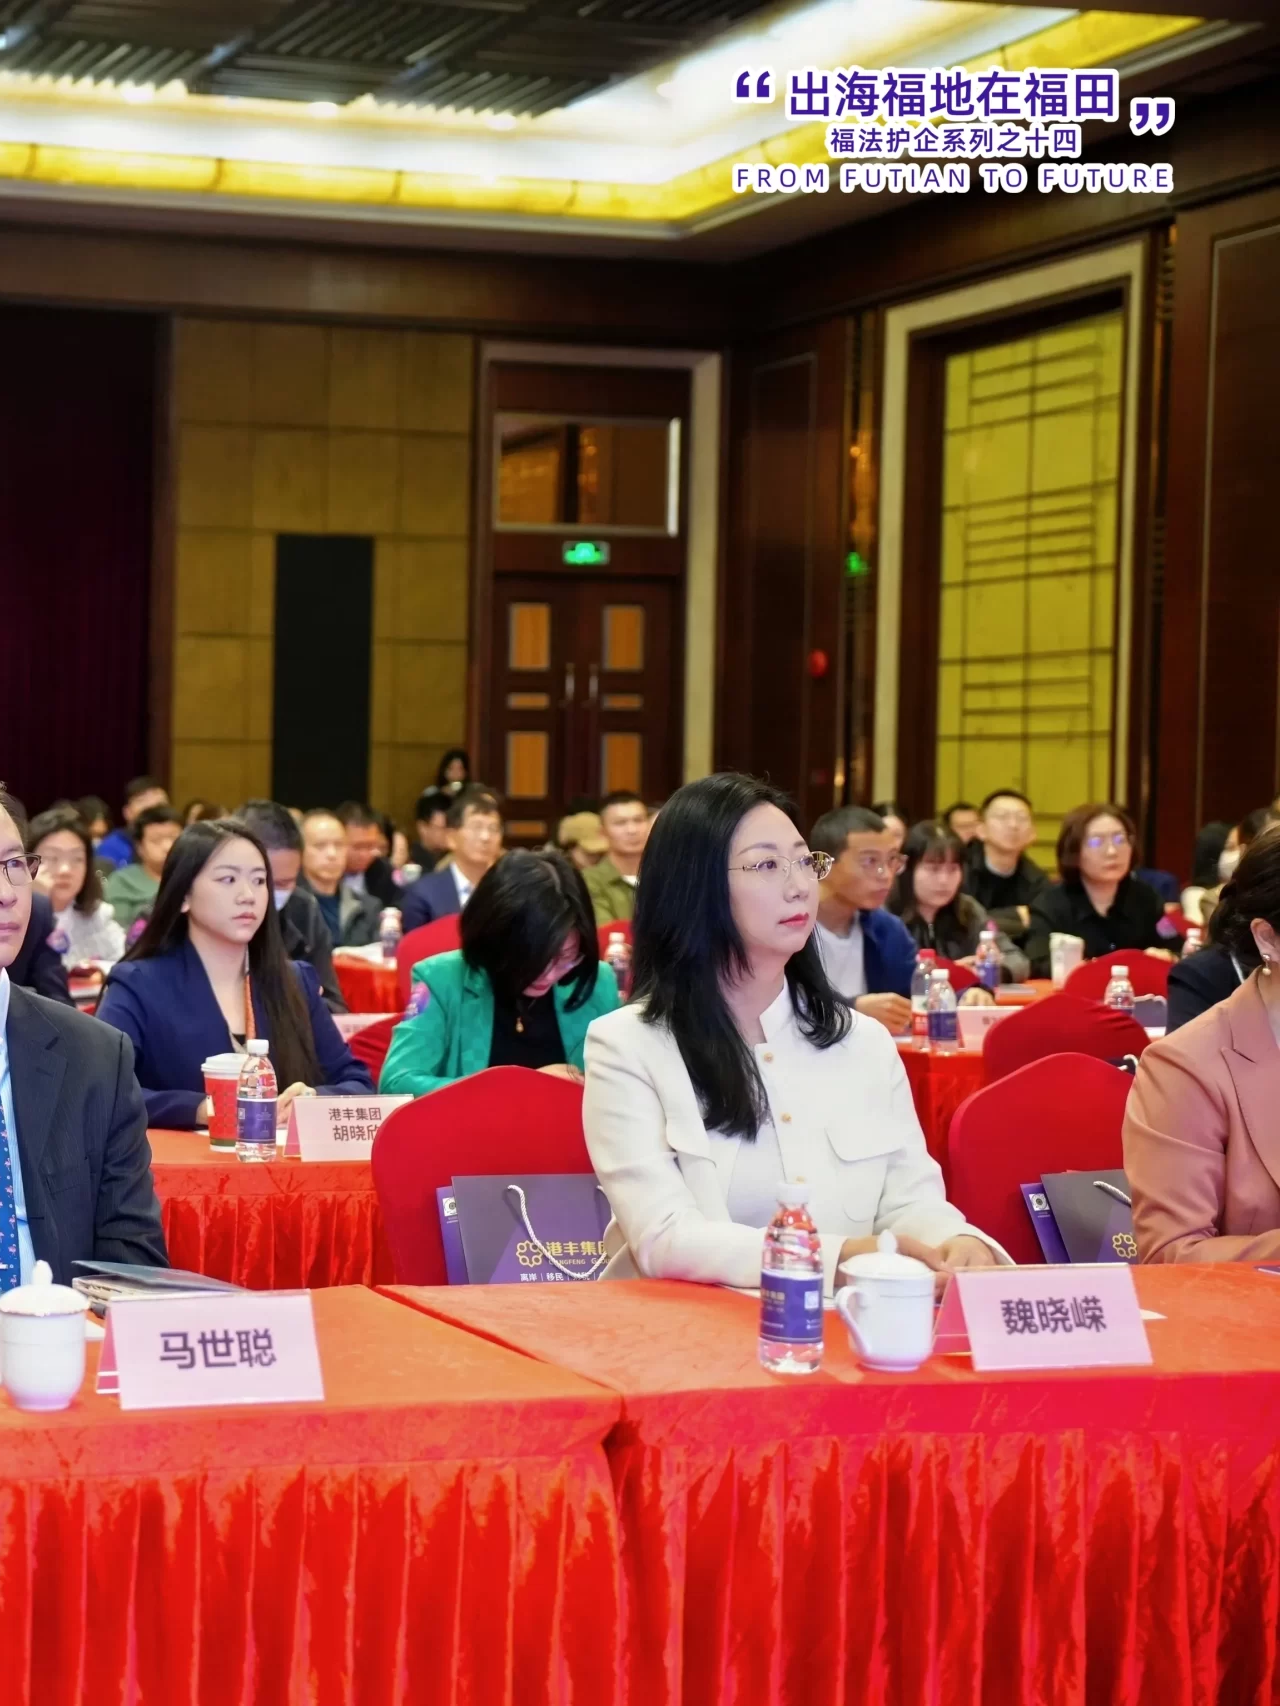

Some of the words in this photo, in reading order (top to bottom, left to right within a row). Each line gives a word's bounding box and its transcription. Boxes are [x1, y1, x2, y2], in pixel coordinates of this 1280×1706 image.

[328, 1107, 382, 1121] 港丰集团
[546, 1272, 564, 1281] 移民
[1000, 1295, 1107, 1335] 魏晓嵘
[159, 1328, 277, 1370] 马世聪
